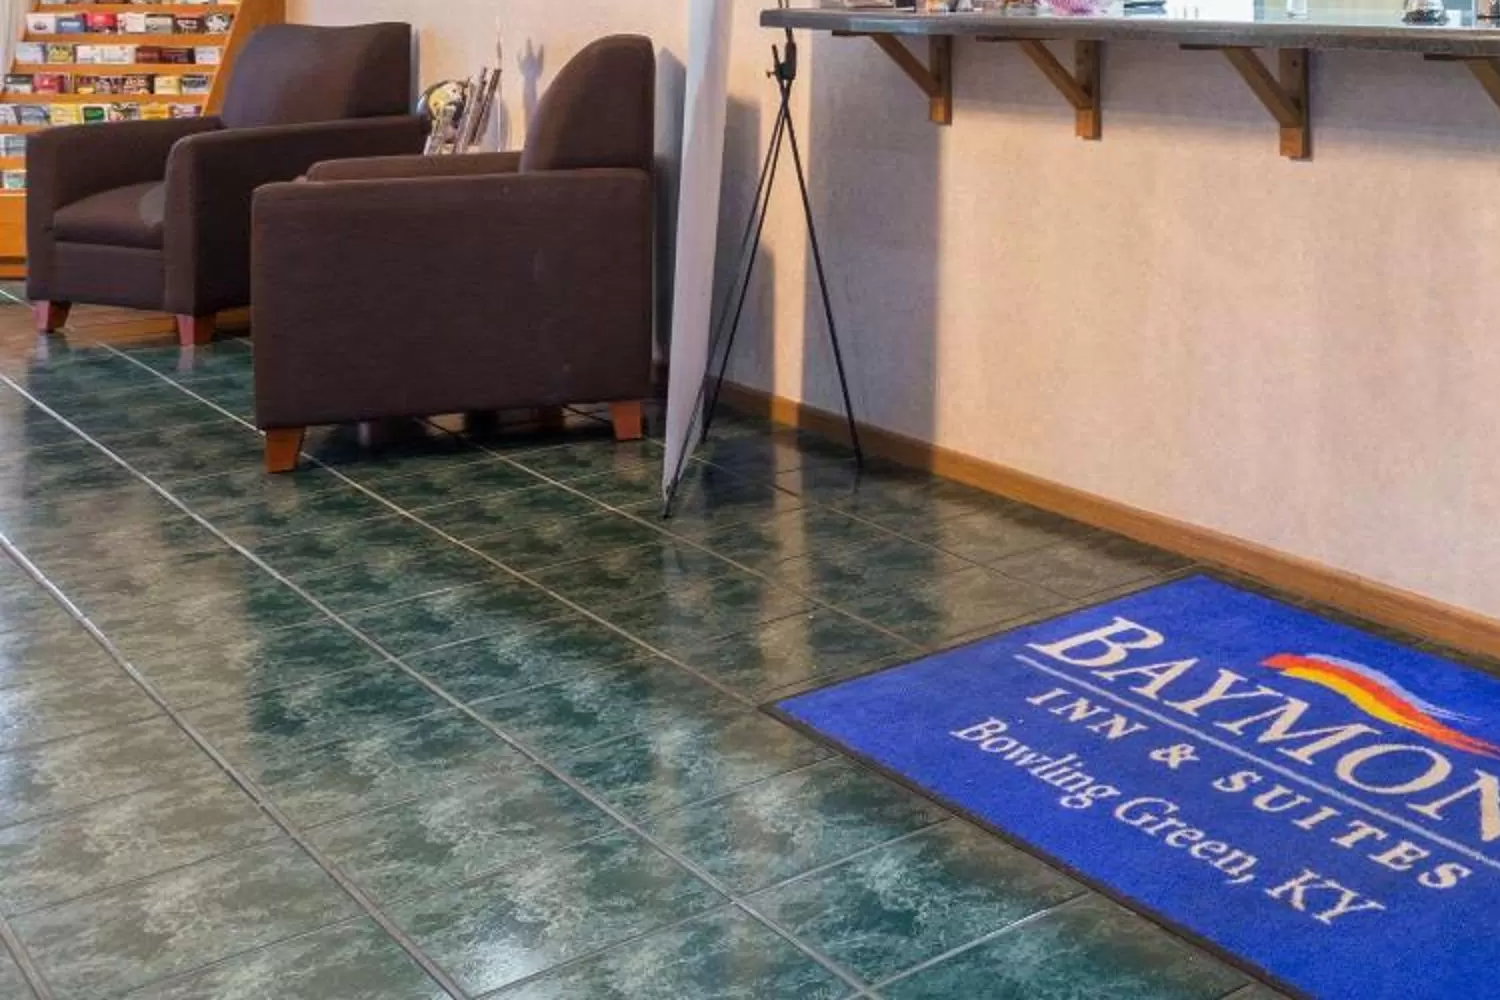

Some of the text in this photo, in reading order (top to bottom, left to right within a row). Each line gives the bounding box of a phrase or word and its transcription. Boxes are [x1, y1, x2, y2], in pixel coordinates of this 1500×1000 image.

[950, 716, 1386, 925] Bowling Green, KY
[1025, 687, 1474, 891] INN & SUITES
